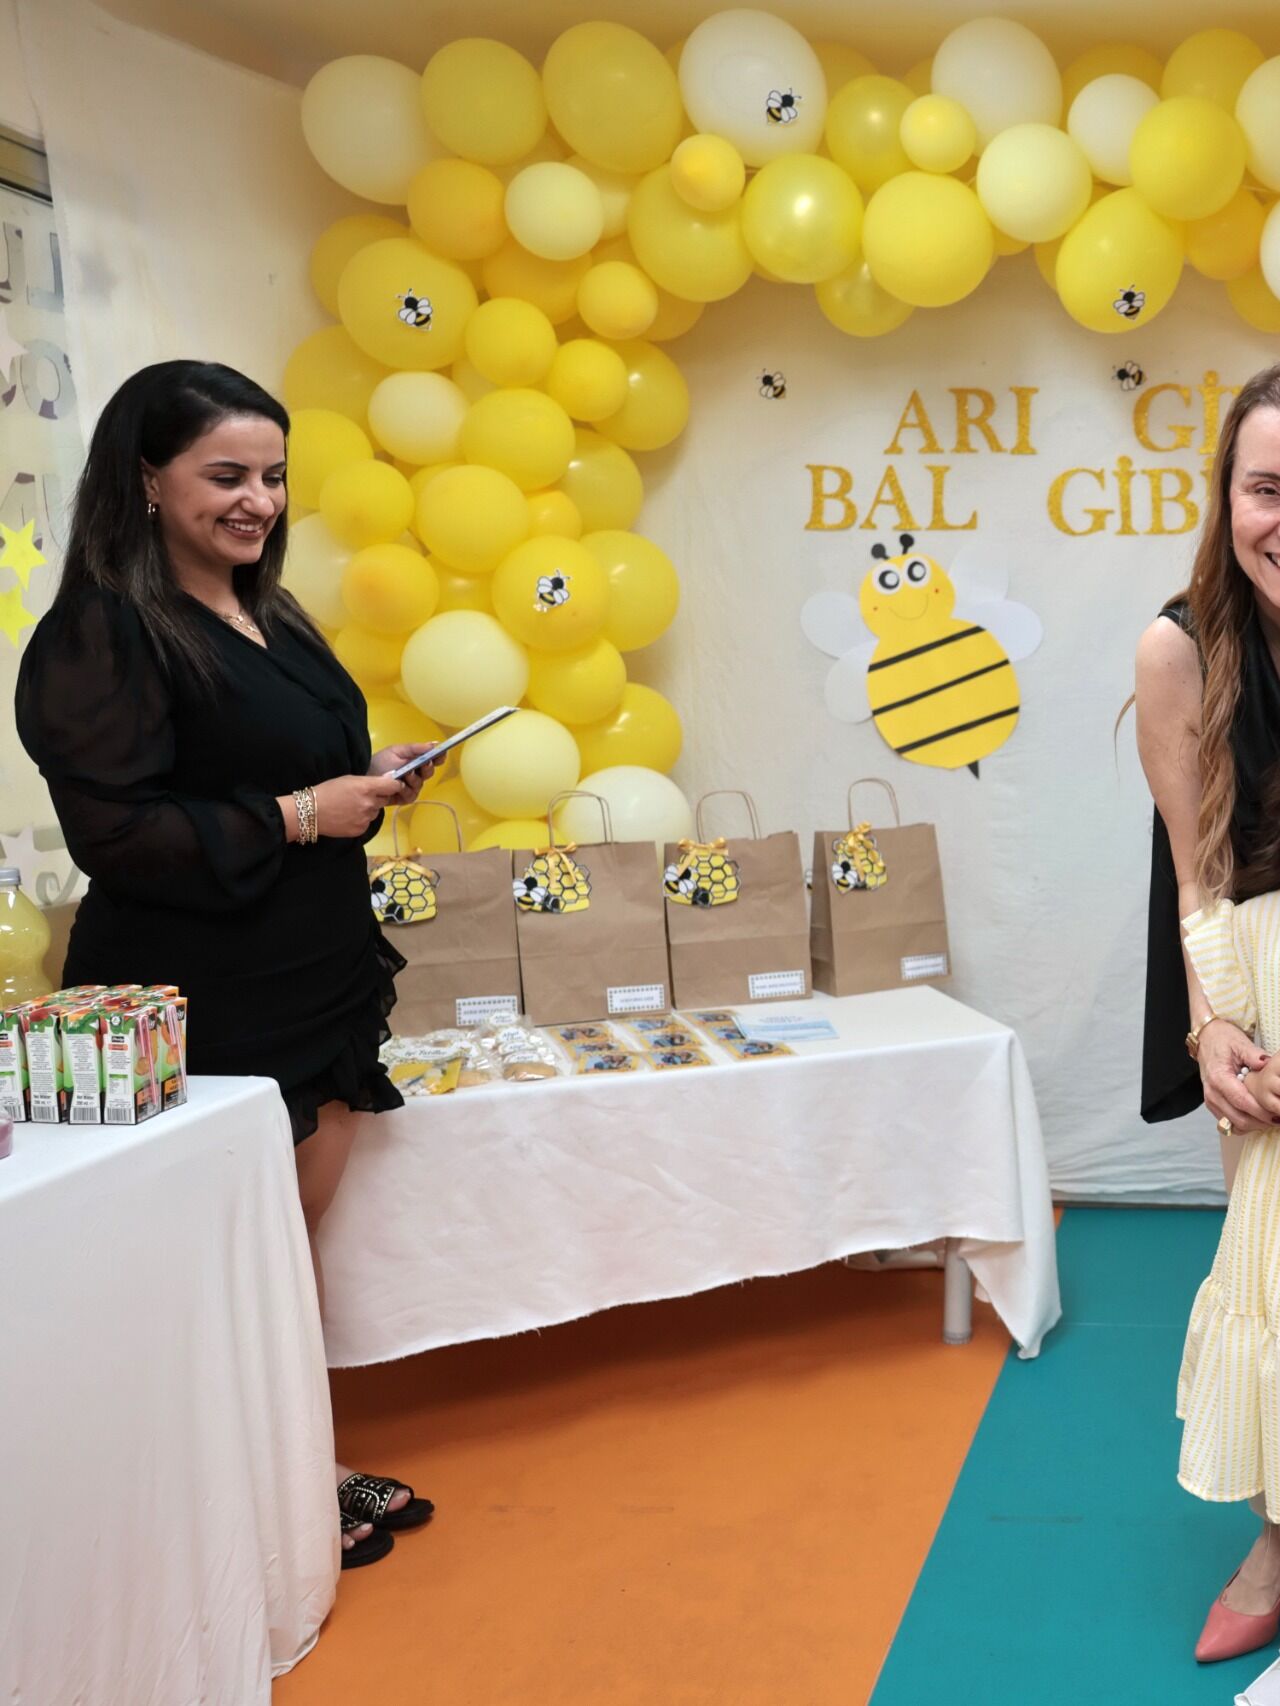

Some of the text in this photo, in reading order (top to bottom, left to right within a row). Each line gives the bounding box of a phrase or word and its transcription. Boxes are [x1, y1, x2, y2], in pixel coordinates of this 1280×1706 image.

[883, 386, 1039, 455] ARI
[1133, 370, 1243, 455] Gİ
[803, 464, 978, 532] BAL
